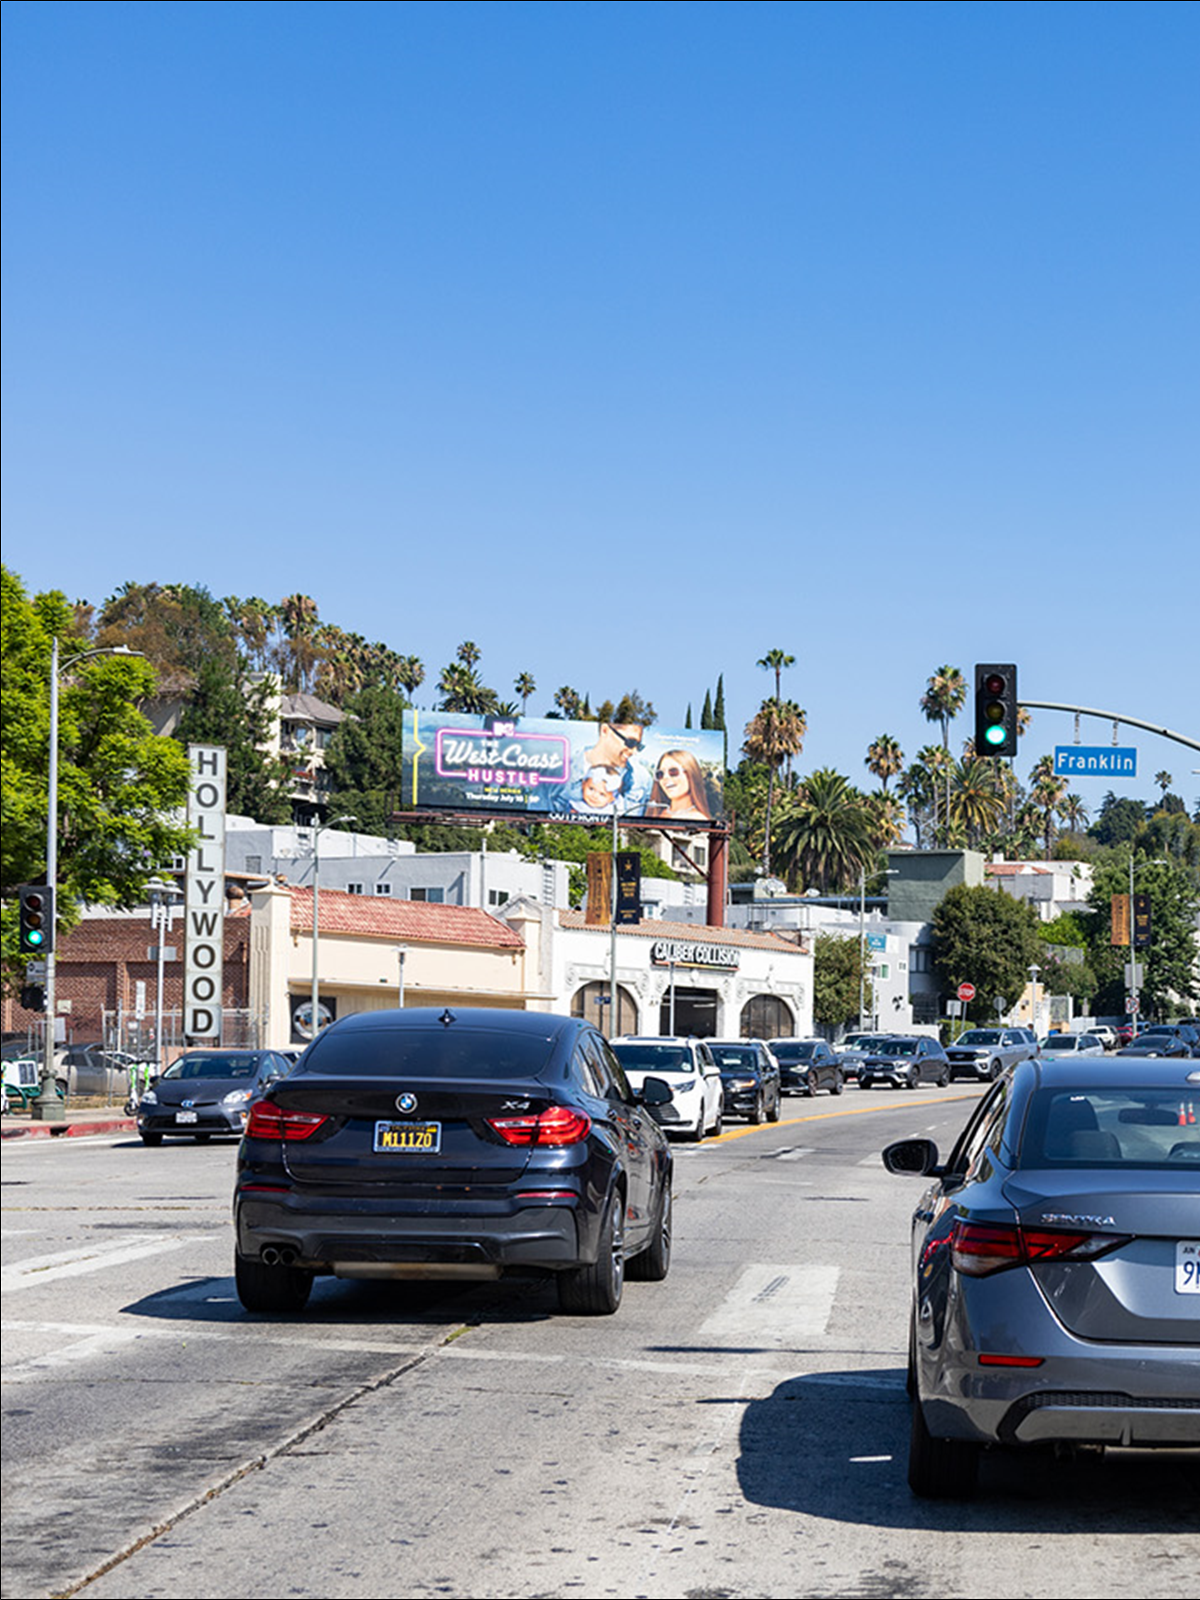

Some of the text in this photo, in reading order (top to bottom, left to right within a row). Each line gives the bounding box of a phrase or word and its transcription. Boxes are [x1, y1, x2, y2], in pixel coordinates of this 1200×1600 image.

[443, 740, 564, 768] West Coast
[1058, 752, 1133, 770] Franklin
[467, 768, 539, 786] HUSTLE
[465, 792, 499, 803] Thursday
[500, 794, 514, 803] July
[191, 750, 219, 1034] HOLLYWOOD
[654, 941, 694, 962] CALIBER
[500, 1101, 530, 1110] X4
